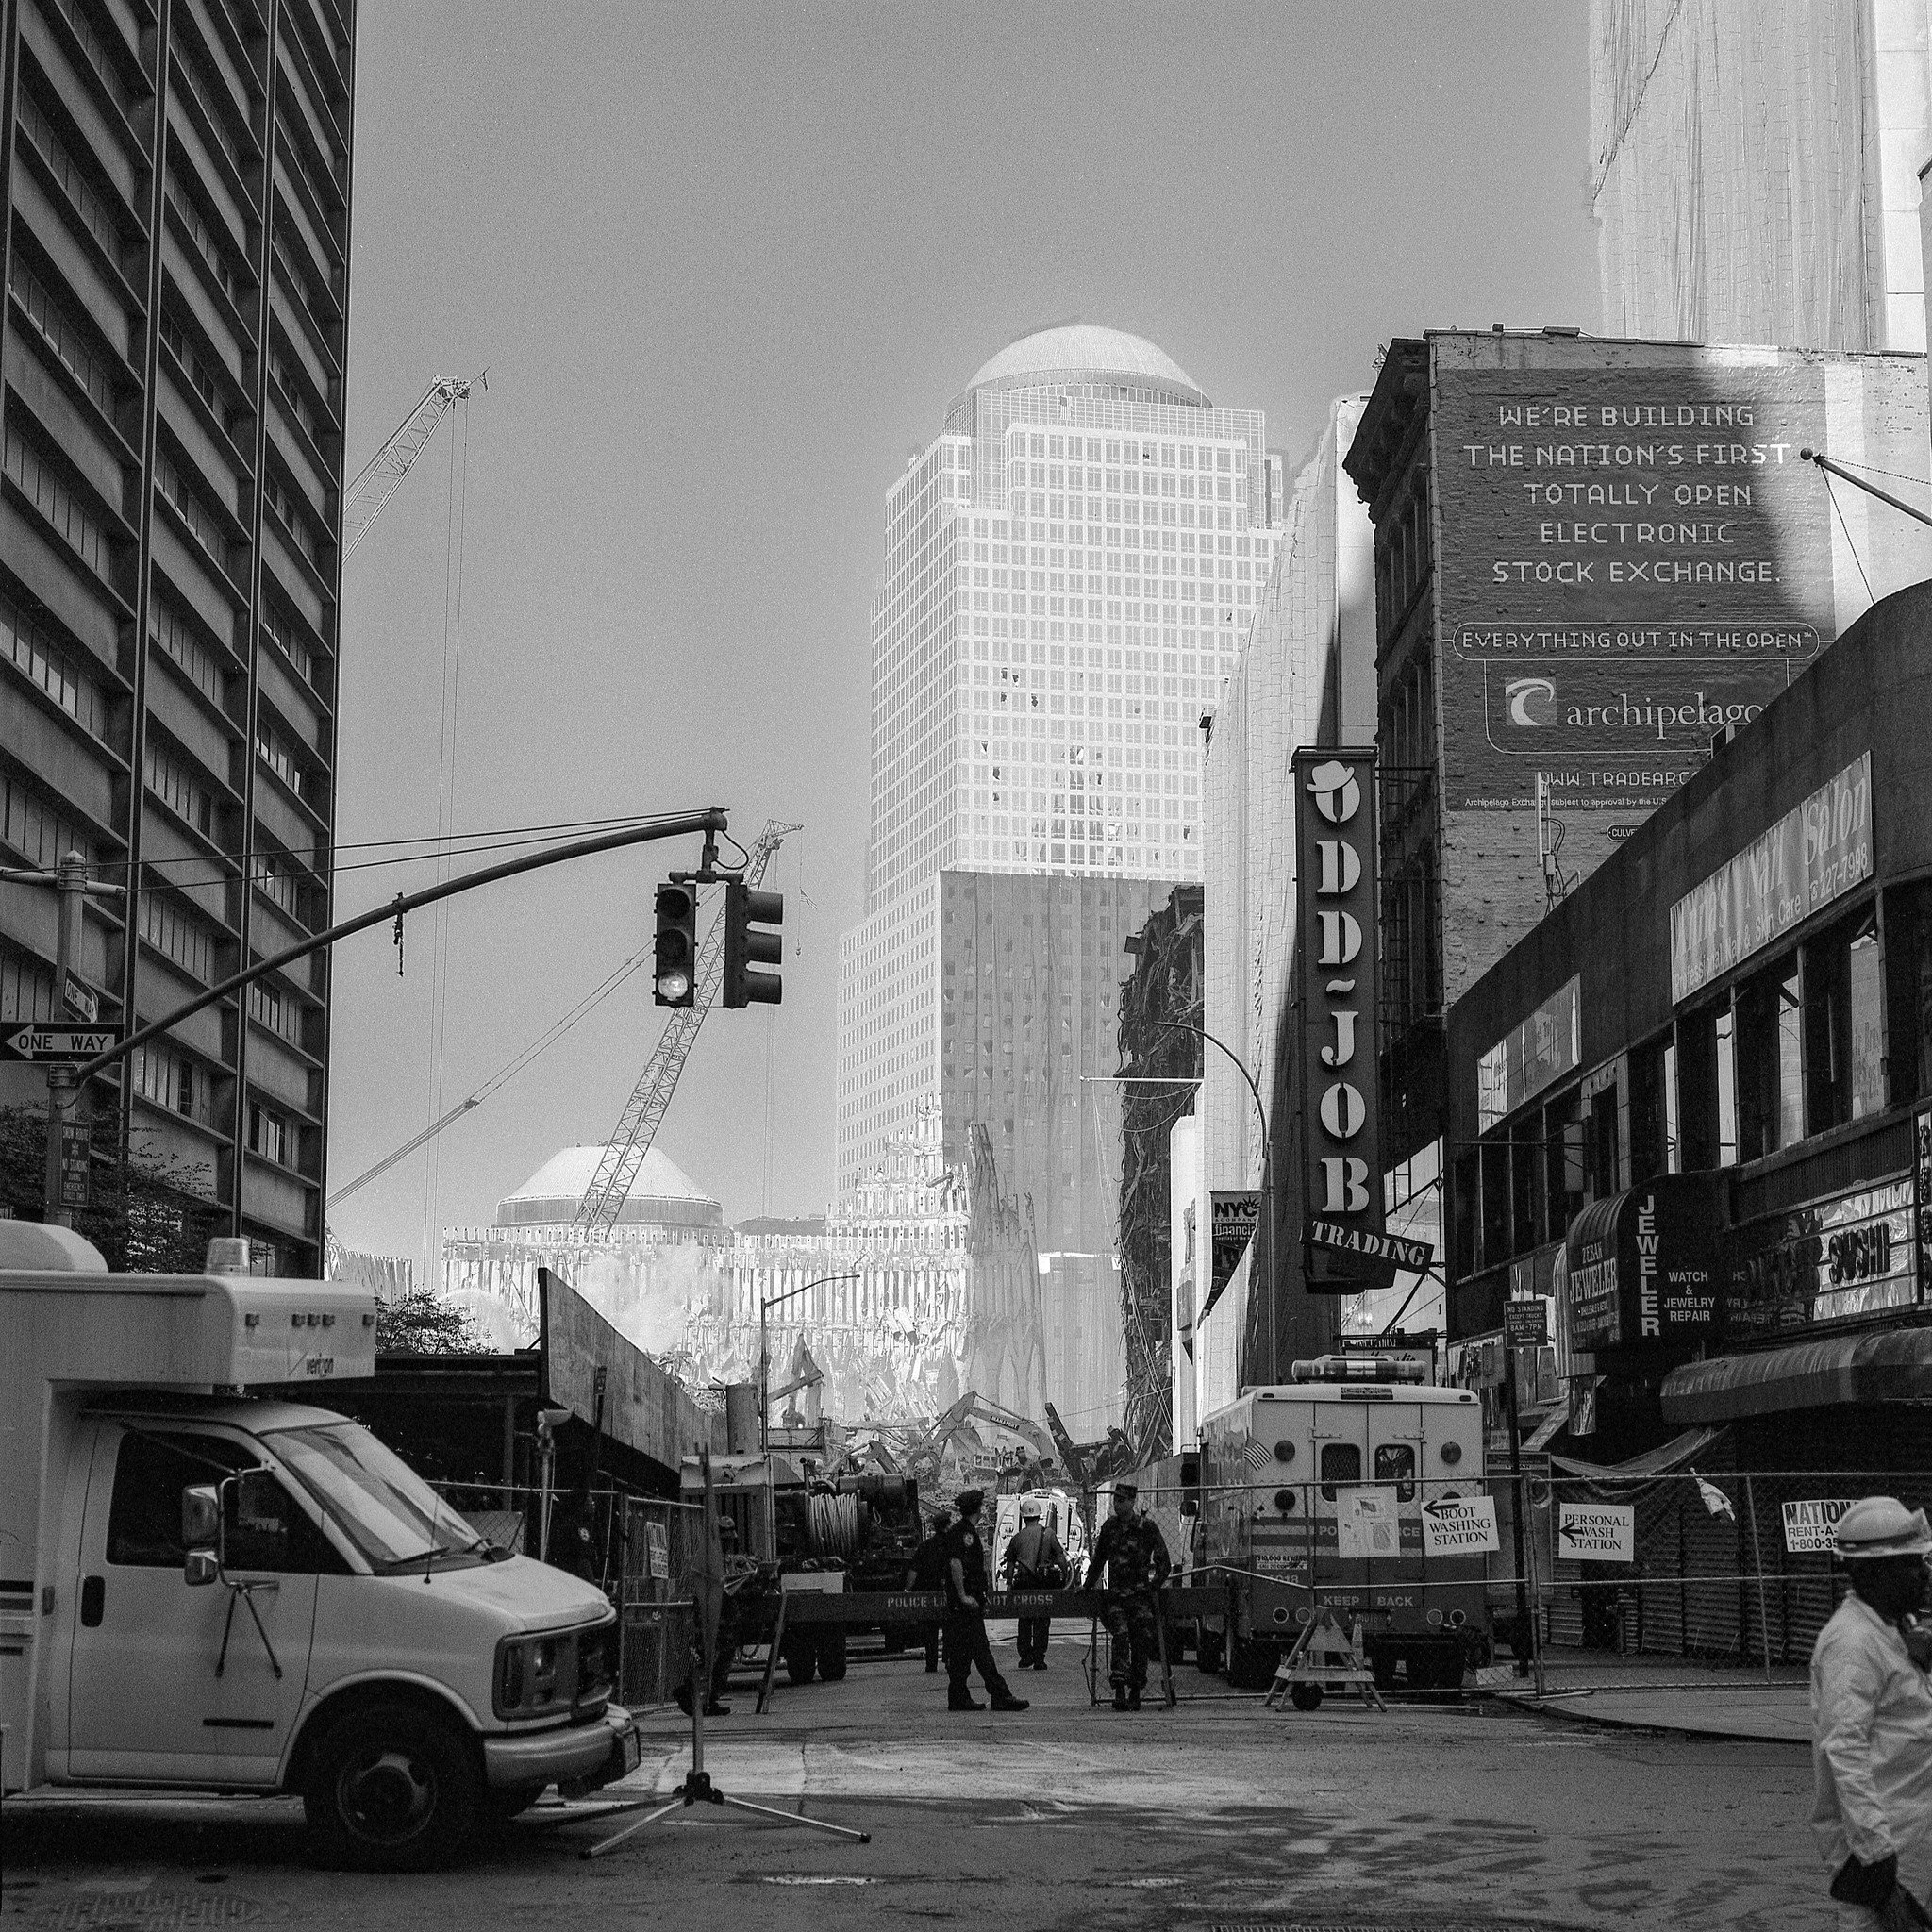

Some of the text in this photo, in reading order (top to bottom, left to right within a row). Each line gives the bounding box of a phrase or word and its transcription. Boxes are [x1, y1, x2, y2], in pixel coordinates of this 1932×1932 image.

[1499, 406, 1754, 426] WE'RE BUILDING
[1462, 443, 1791, 466] THE NATION'S FIRST
[1523, 483, 1751, 506] TOTALLY OPEN
[1541, 523, 1738, 544] ELECTRONIC
[1492, 561, 1780, 583] STOCK EXCHANGE.
[1462, 632, 1611, 648] EVERYTHING
[1616, 631, 1662, 648] OUT
[1668, 631, 1694, 648] IN
[1698, 632, 1741, 649] THE
[1566, 691, 1765, 740] archipelago
[1540, 772, 1697, 787] WWW.TRADEARC
[1464, 798, 1509, 808] Archipelago
[1550, 798, 1579, 808] subject
[1581, 798, 1590, 807] to
[1591, 798, 1624, 808] approval
[1626, 797, 1637, 808] by
[1804, 777, 1867, 867] Salon
[1611, 828, 1638, 838] CULVE
[1778, 894, 1801, 925] Care
[19, 1034, 108, 1052] ONE WAY
[1214, 1196, 1259, 1218] NYC
[1215, 1224, 1257, 1236] financia
[1311, 1220, 1426, 1266] TRADING
[1635, 1194, 1661, 1337] JEWELER
[1569, 1257, 1619, 1305] JEWELER
[1668, 1271, 1709, 1283] WATCH
[1685, 1284, 1694, 1296] &
[1517, 1305, 1544, 1313] STANDING
[1663, 1297, 1716, 1309] JEWELRY
[1669, 1309, 1711, 1322] REPAIR
[1441, 1506, 1476, 1520] BOOT
[1564, 1513, 1629, 1527] PERSONAL
[1784, 1501, 1857, 1525] NATION
[1428, 1518, 1491, 1533] WASHING
[1578, 1525, 1614, 1538] WASH
[1434, 1530, 1488, 1546] STATION
[1570, 1538, 1622, 1550] STATION
[887, 1596, 927, 1607] POLICE
[1013, 1594, 1053, 1606] CROSS
[1324, 1595, 1414, 1607] KEEP BACK
